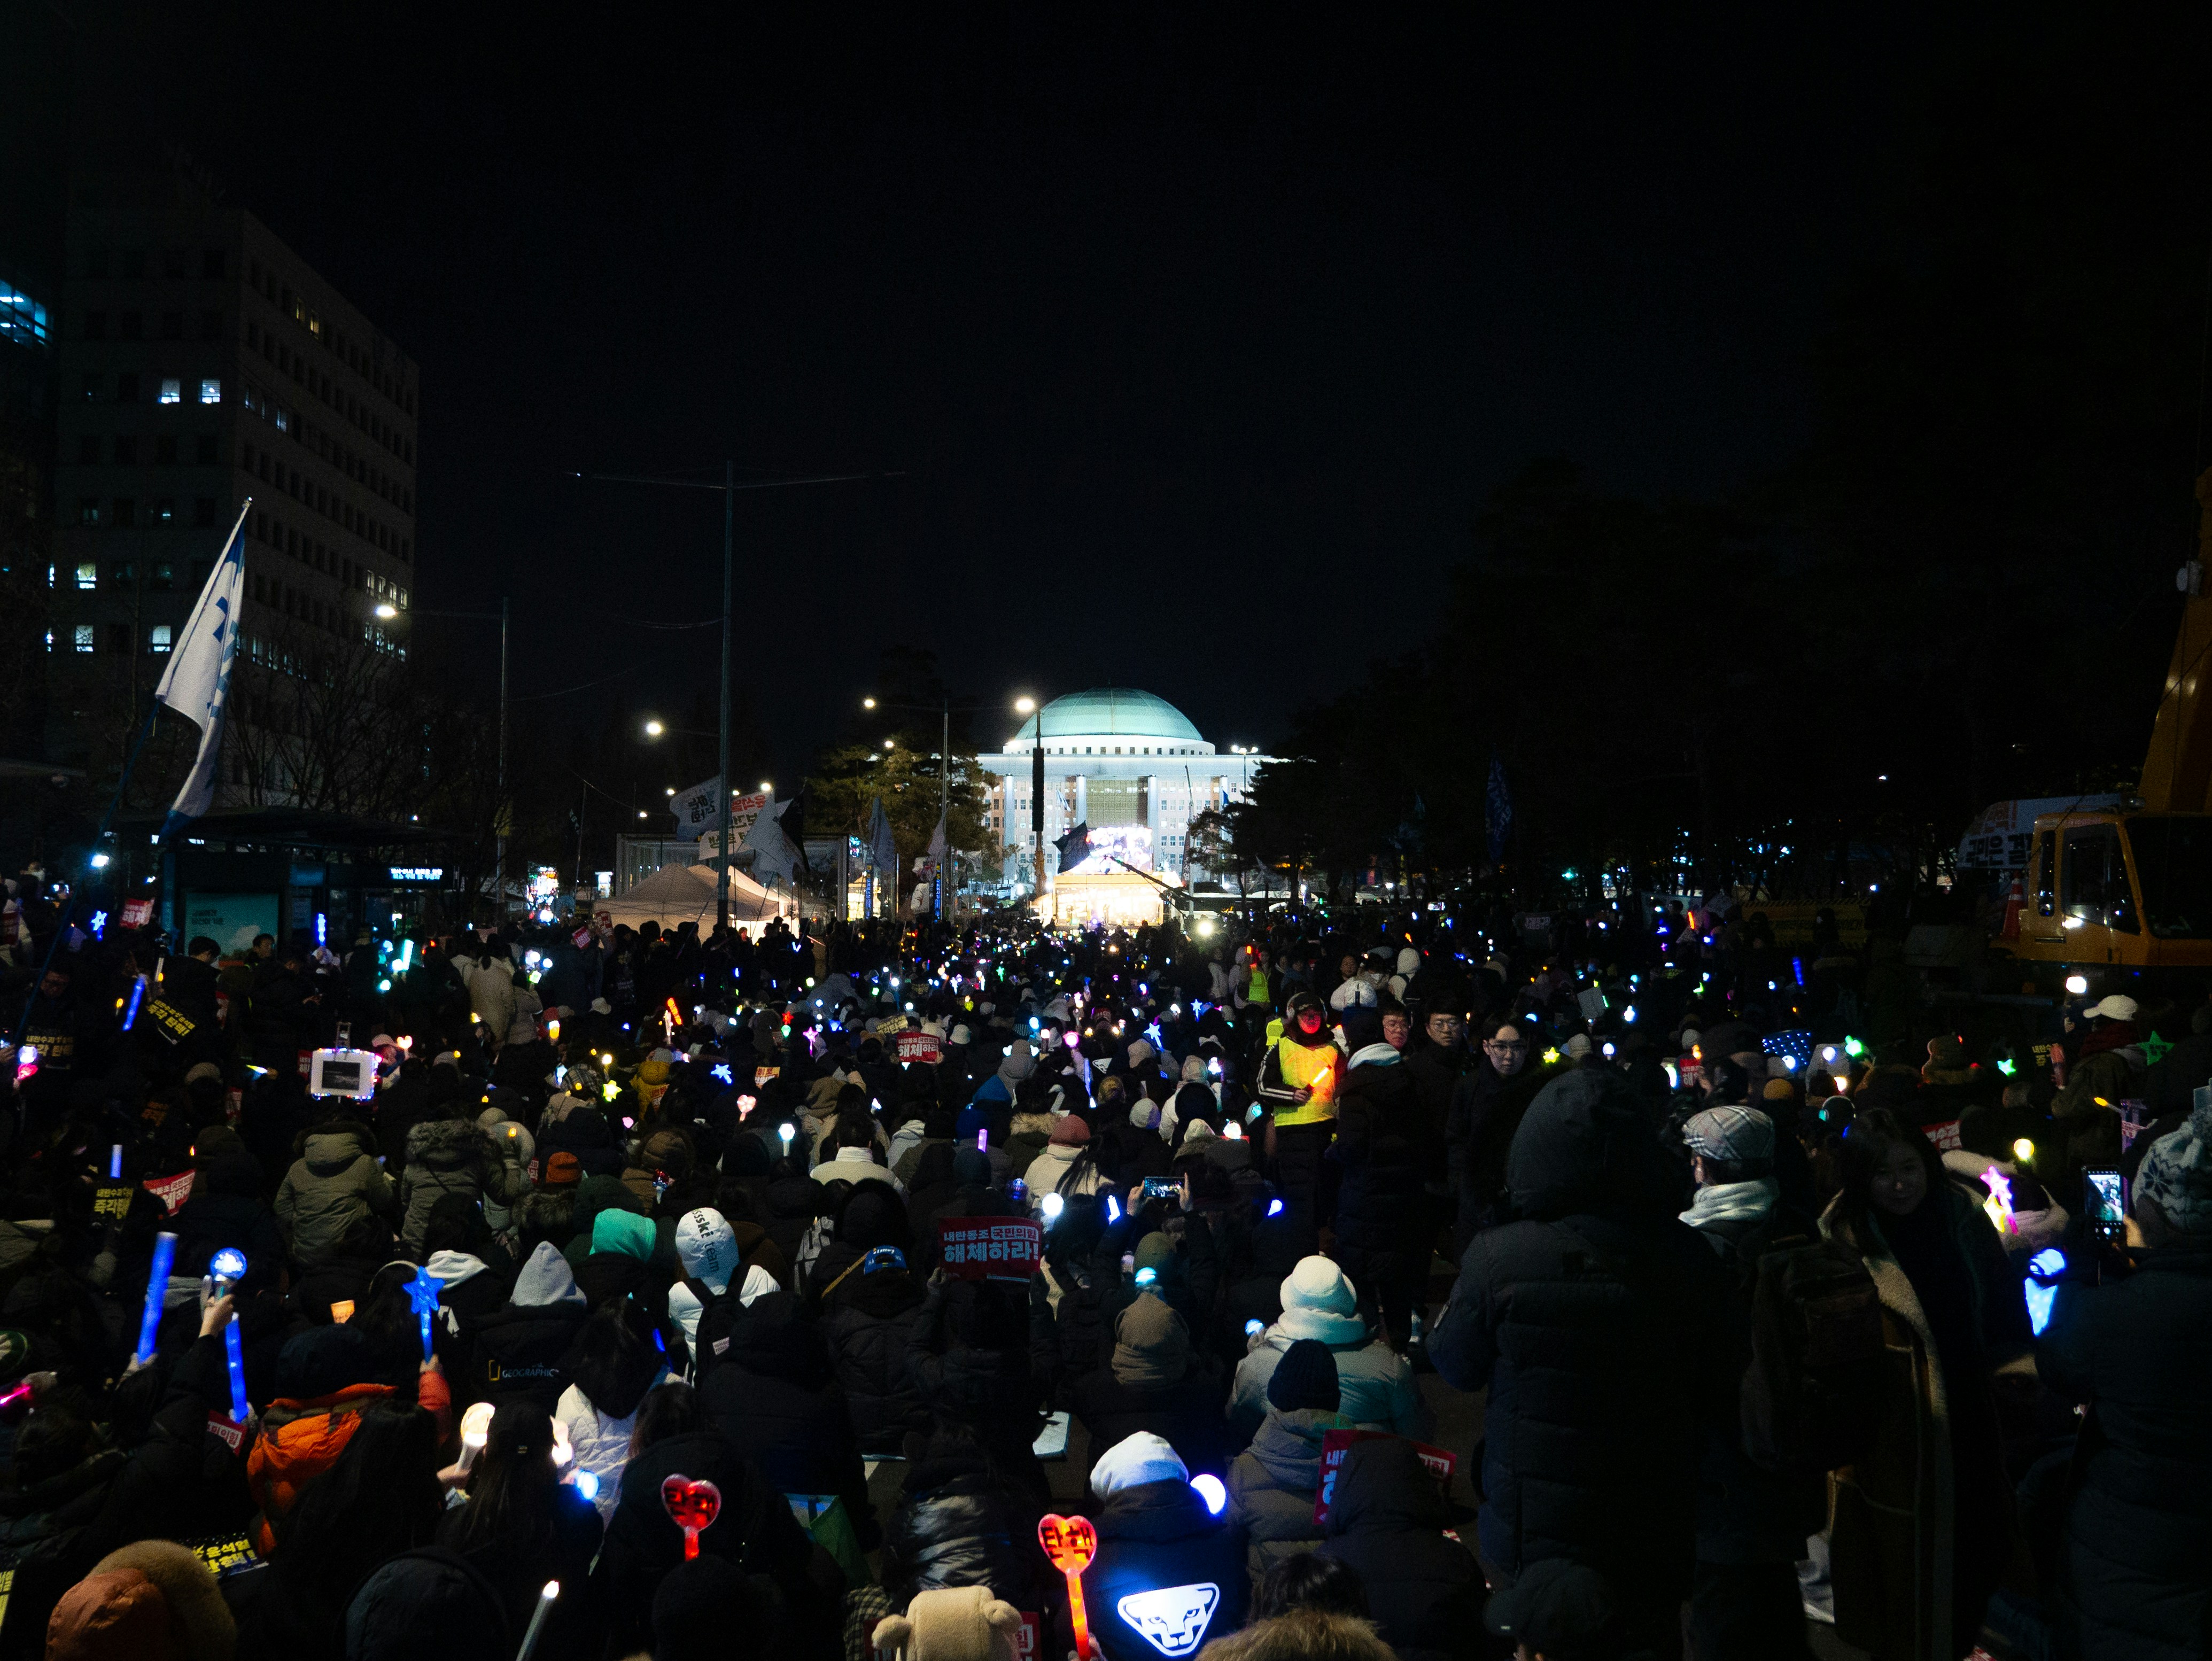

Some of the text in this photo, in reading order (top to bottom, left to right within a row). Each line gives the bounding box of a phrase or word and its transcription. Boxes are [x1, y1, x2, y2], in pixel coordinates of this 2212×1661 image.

[944, 1225, 1039, 1243] 내란동조 국민의힘
[944, 1241, 1039, 1263] 해체하라!
[502, 1369, 556, 1378] GEOGRAPHIC
[1041, 1526, 1093, 1559] 탄핵
